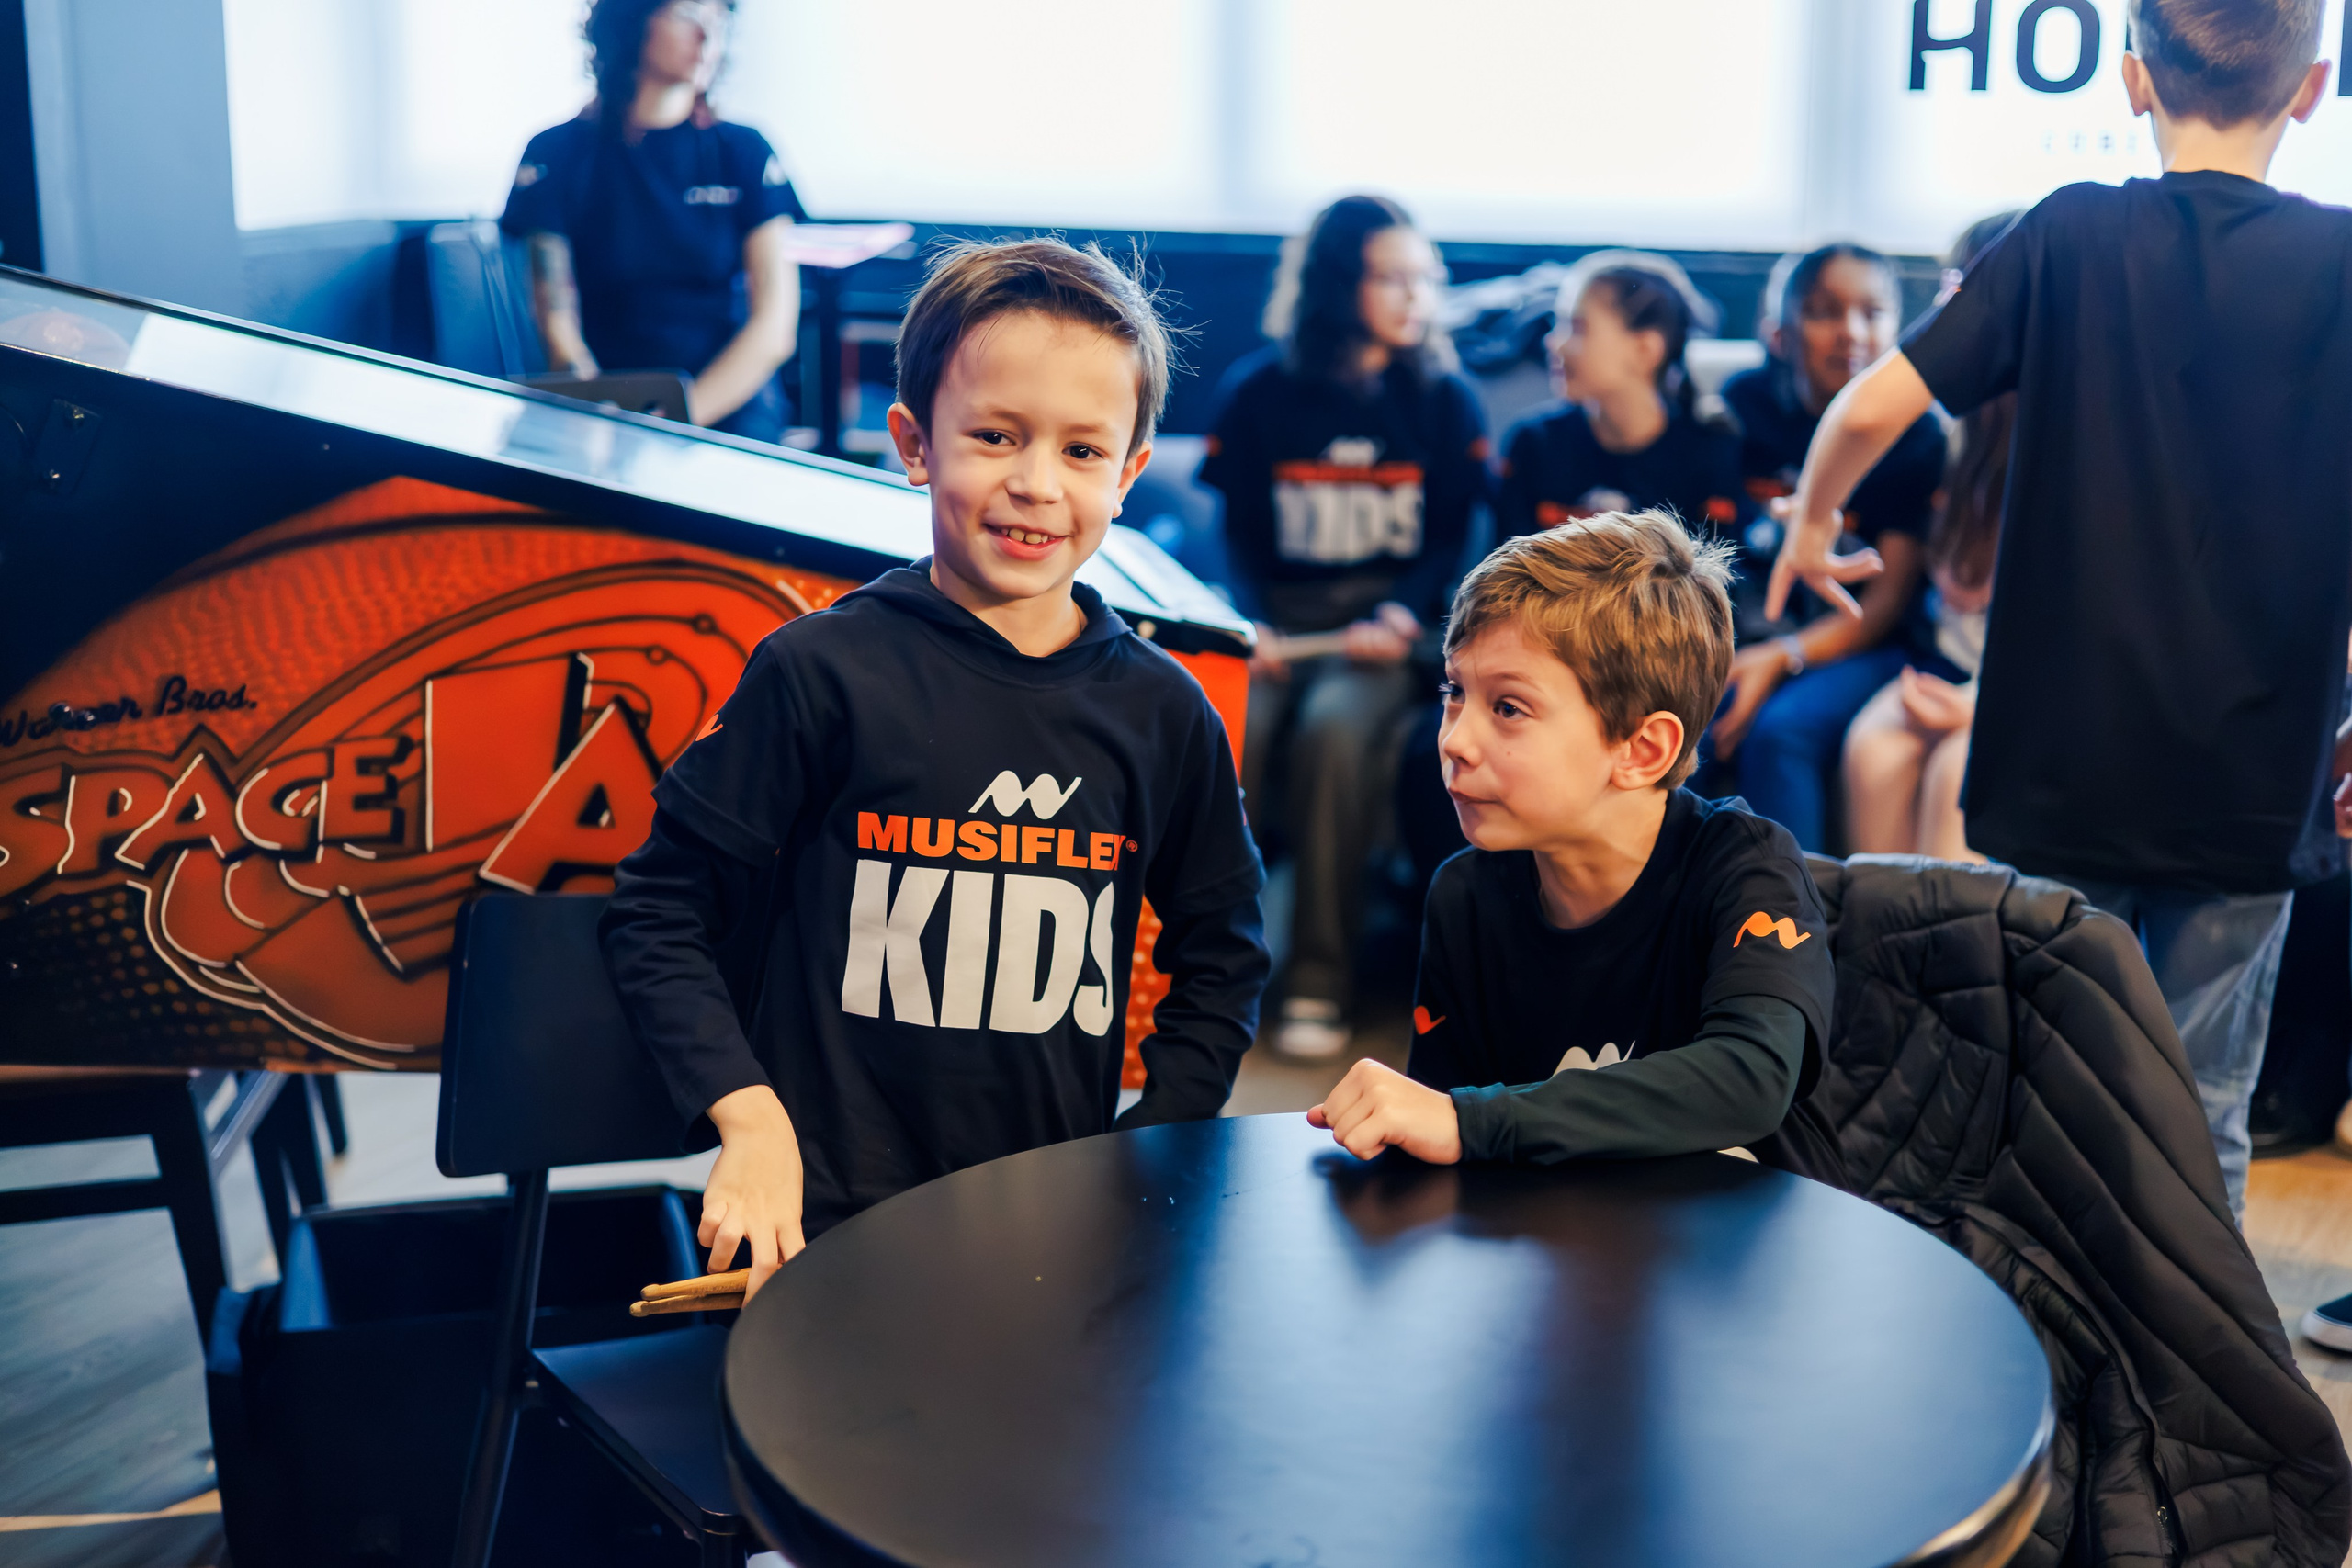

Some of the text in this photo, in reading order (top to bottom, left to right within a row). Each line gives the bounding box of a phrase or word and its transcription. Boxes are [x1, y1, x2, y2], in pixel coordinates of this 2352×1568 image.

[156, 674, 258, 716] Bros.
[0, 733, 406, 897] SPACE
[842, 859, 1114, 1037] KIDS
